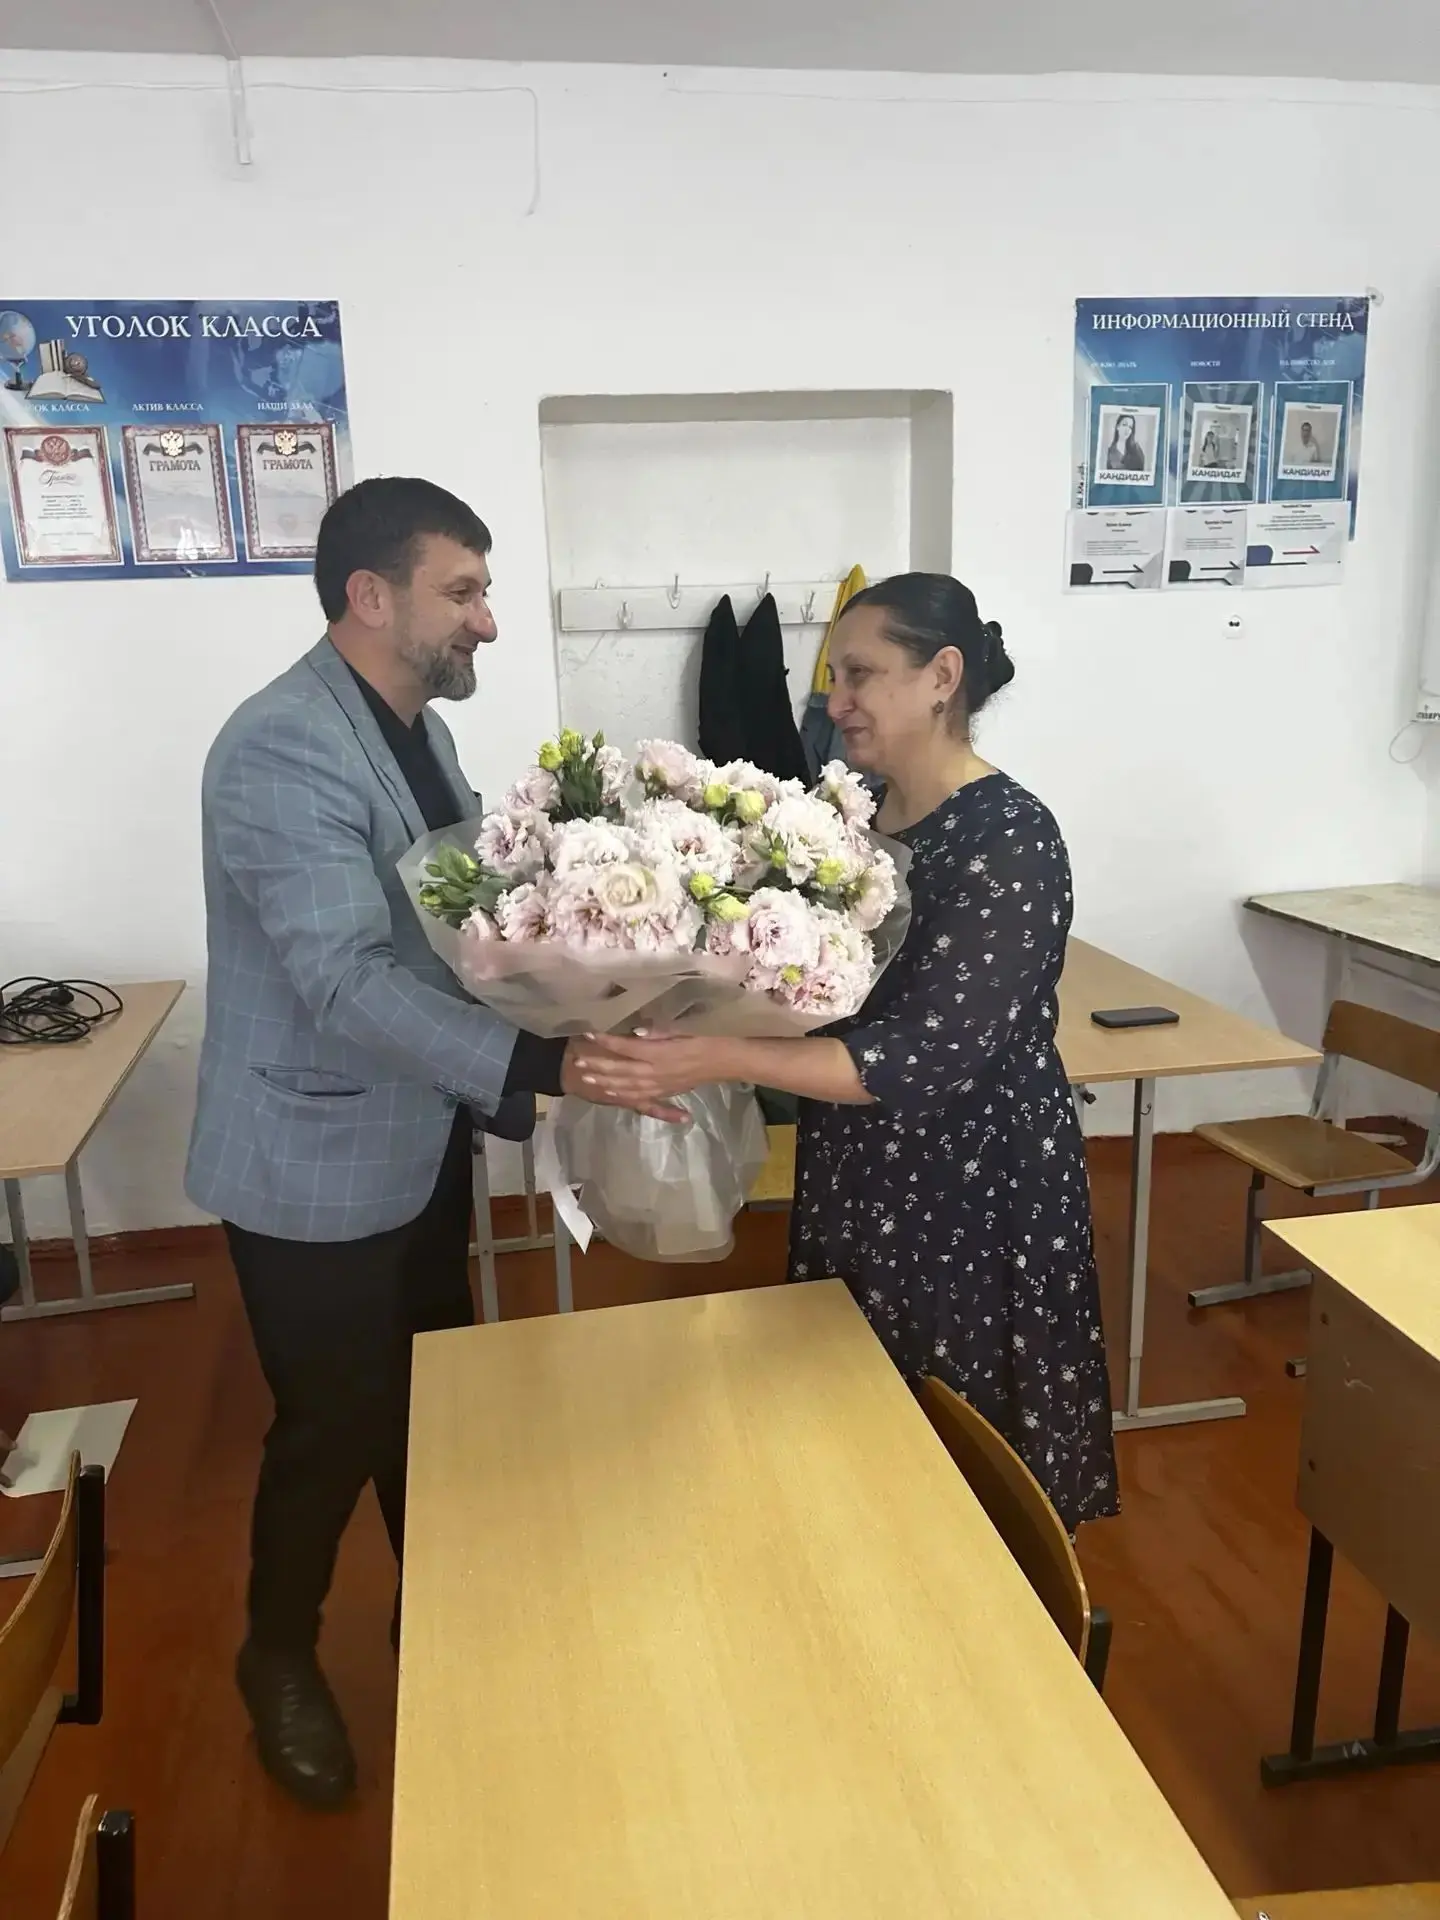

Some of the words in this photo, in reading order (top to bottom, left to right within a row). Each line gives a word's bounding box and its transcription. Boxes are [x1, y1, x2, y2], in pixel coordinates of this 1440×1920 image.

[1092, 309, 1291, 332] ИНФОРМАЦИОННЫЙ
[1296, 312, 1354, 332] СТЕНД
[65, 315, 192, 338] УГОЛОК
[201, 315, 323, 338] КЛАССА
[51, 403, 90, 413] КЛАССА
[132, 403, 164, 412] АКТИВ
[166, 403, 204, 412] КЛАССА
[257, 402, 287, 412] НАШИ
[149, 460, 201, 472] ГРАМОТА
[263, 459, 314, 471] ГРАМОТА
[1098, 472, 1151, 482] КАНДИДАТ
[1191, 469, 1242, 479] КАНДИДАТ
[1282, 468, 1331, 478] КАНДИДАТ
